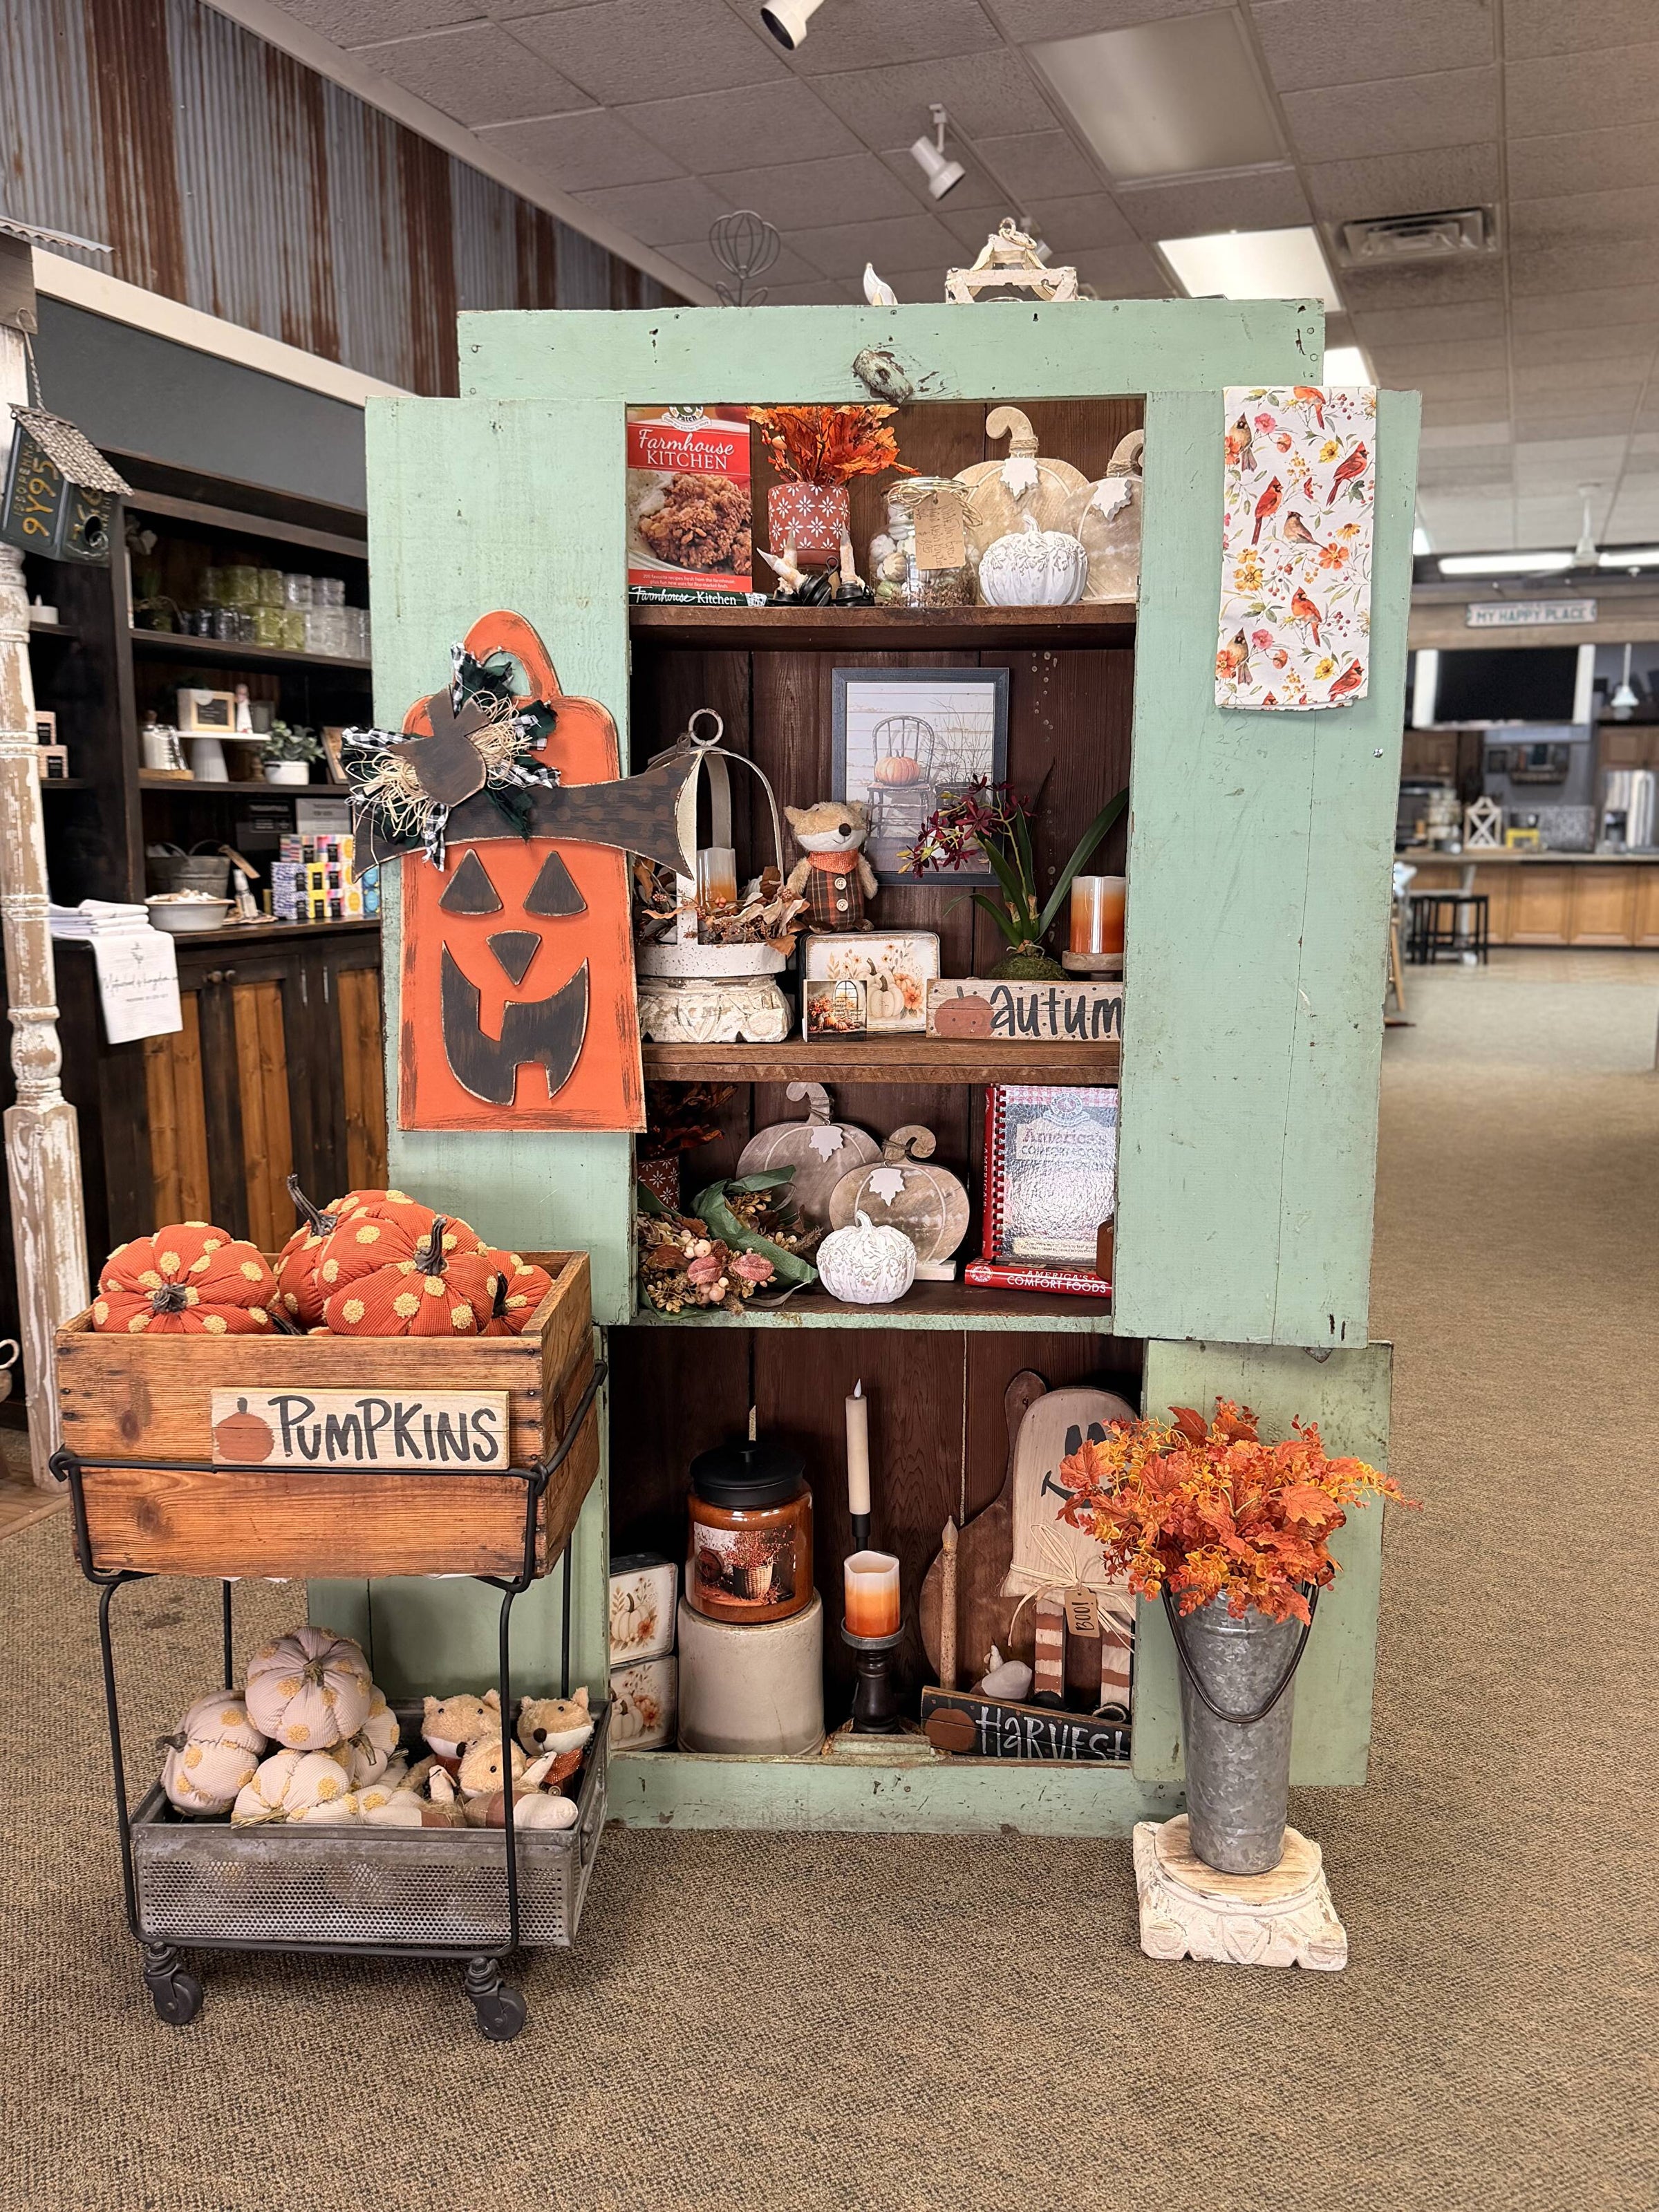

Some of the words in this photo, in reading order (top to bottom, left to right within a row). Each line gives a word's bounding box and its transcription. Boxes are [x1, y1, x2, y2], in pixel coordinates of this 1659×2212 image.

[639, 429, 735, 456] Farmhouse
[646, 450, 728, 470] KITCHEN
[22, 446, 59, 537] 9Y95
[629, 586, 695, 603] Farmhouse
[695, 591, 737, 606] Kitchen
[1476, 611, 1494, 622] MY
[1498, 608, 1541, 621] HAPPY
[1544, 606, 1587, 620] PLACE
[990, 985, 1122, 1040] autum
[1006, 1275, 1062, 1289] COMFORT
[1066, 1281, 1107, 1293] FOODS
[1027, 1270, 1089, 1282] AMERICA'S
[268, 1394, 499, 1463] PUMPKINS
[1071, 1601, 1095, 1631] BOO!
